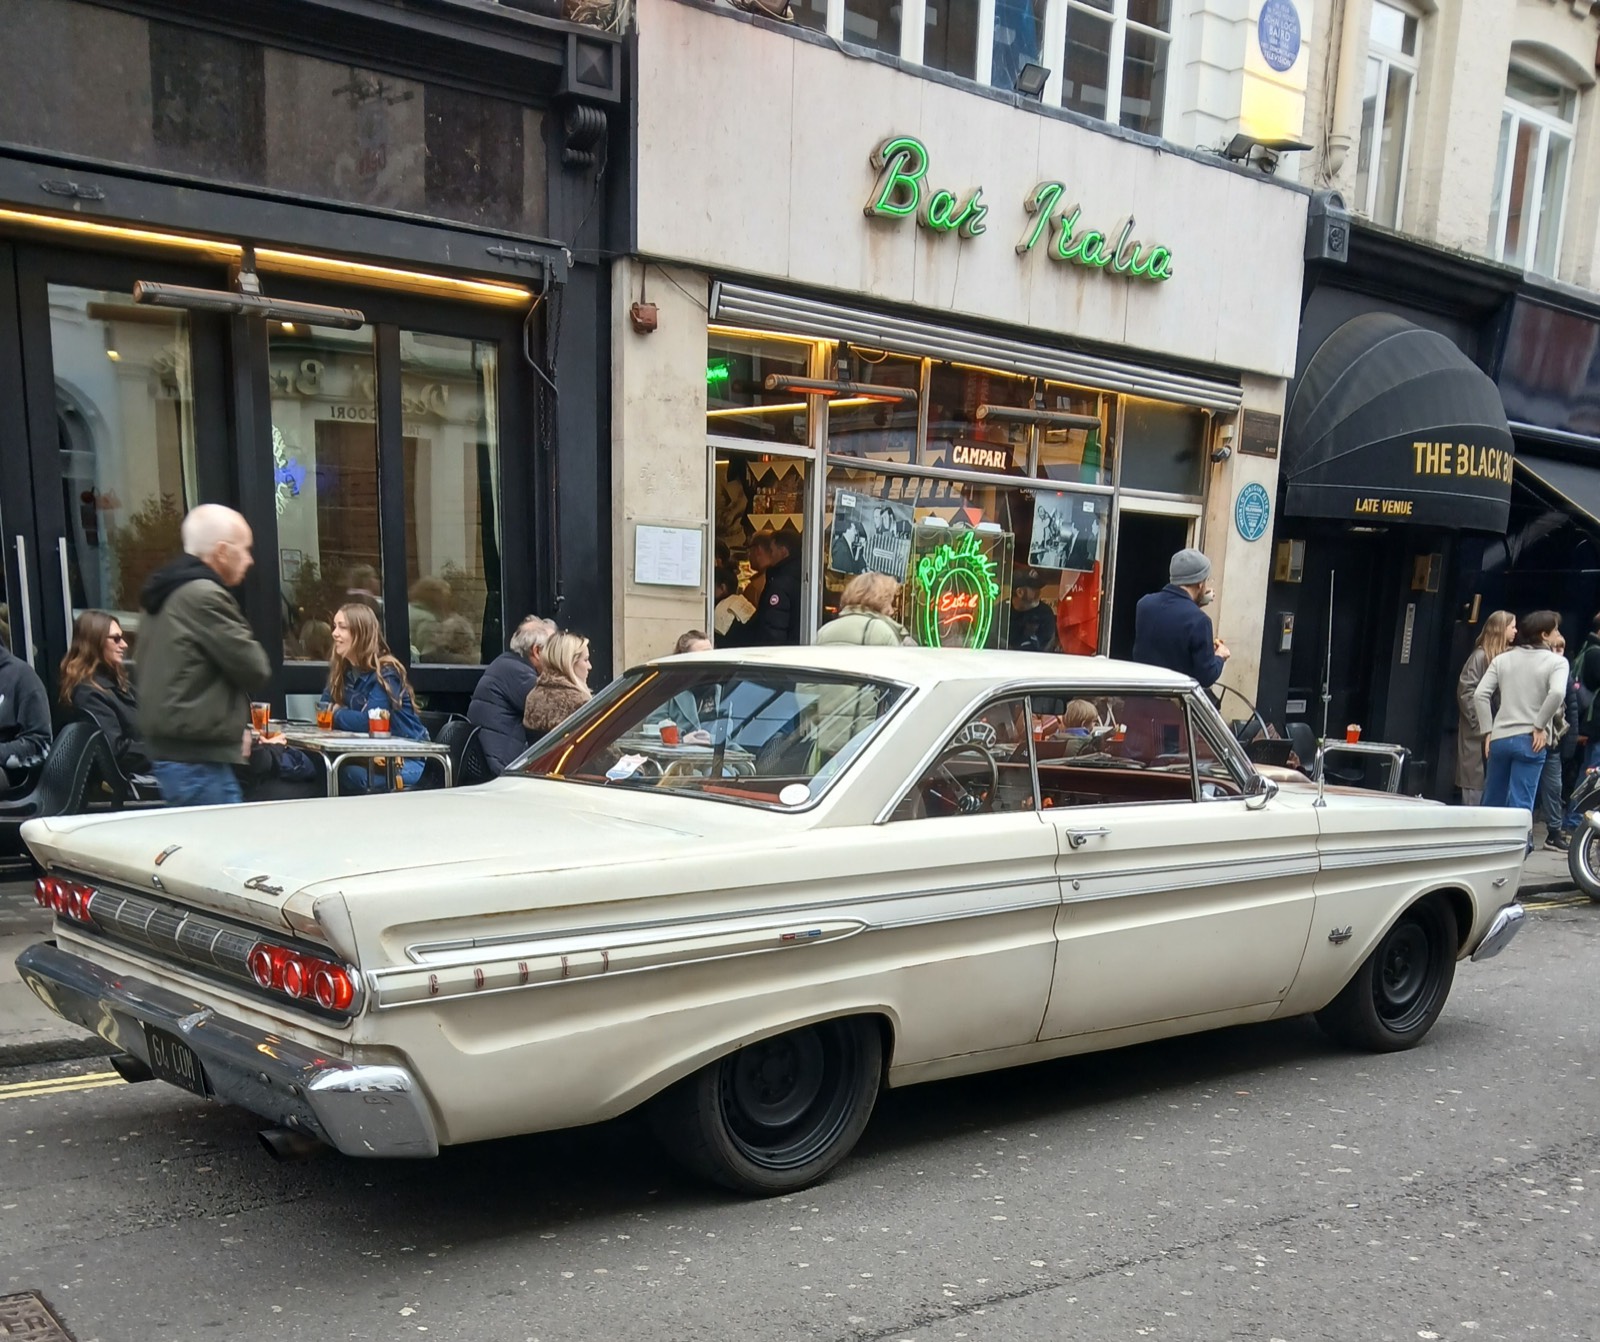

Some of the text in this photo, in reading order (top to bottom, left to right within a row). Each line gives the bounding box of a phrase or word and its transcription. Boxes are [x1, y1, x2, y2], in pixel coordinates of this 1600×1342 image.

[1269, 25, 1290, 42] BAIRD
[863, 135, 1174, 283] Bar Italia
[953, 446, 1006, 470] CAMPARI
[1413, 441, 1452, 474] THE
[1456, 443, 1502, 480] BLACK
[1244, 484, 1263, 496] ORIGIN
[1355, 498, 1413, 515] LATE VENUE
[919, 531, 999, 601] Bar Italia
[152, 1034, 169, 1070] 64
[172, 1042, 195, 1082] COM
